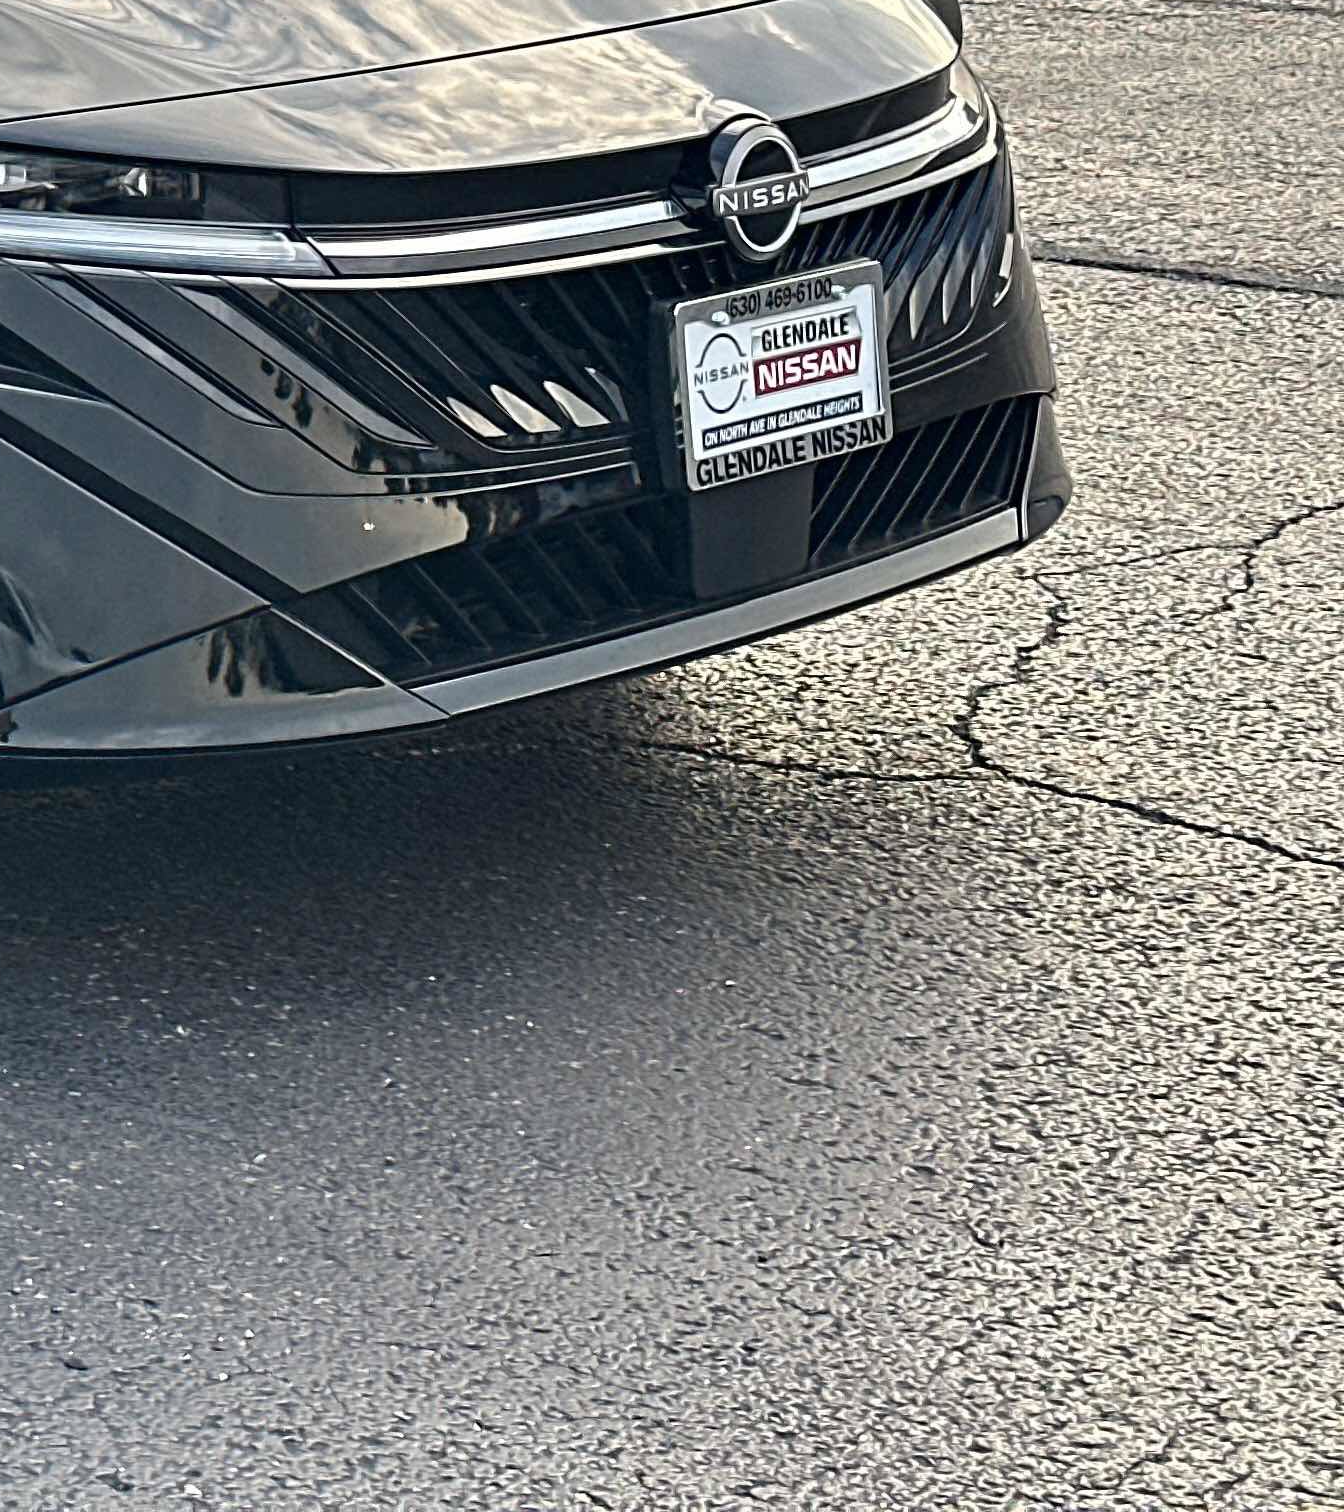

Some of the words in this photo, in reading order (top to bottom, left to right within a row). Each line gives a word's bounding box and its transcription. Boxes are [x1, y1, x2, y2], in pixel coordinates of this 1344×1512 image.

[719, 174, 810, 215] NISSAN
[726, 291, 761, 318] (630)
[765, 277, 832, 310] 469-6100
[761, 313, 849, 352] GLENDALE
[694, 361, 749, 386] NISSAN
[758, 344, 856, 390] NISSAN
[705, 431, 718, 447] ON
[720, 423, 748, 443] NORTH
[749, 417, 766, 435] AVE
[767, 415, 777, 430] IN
[778, 403, 823, 428] GLENDALE
[823, 395, 861, 417] HEIGHTS
[696, 435, 806, 486] GLENDALE
[812, 415, 886, 458] NISSAN
